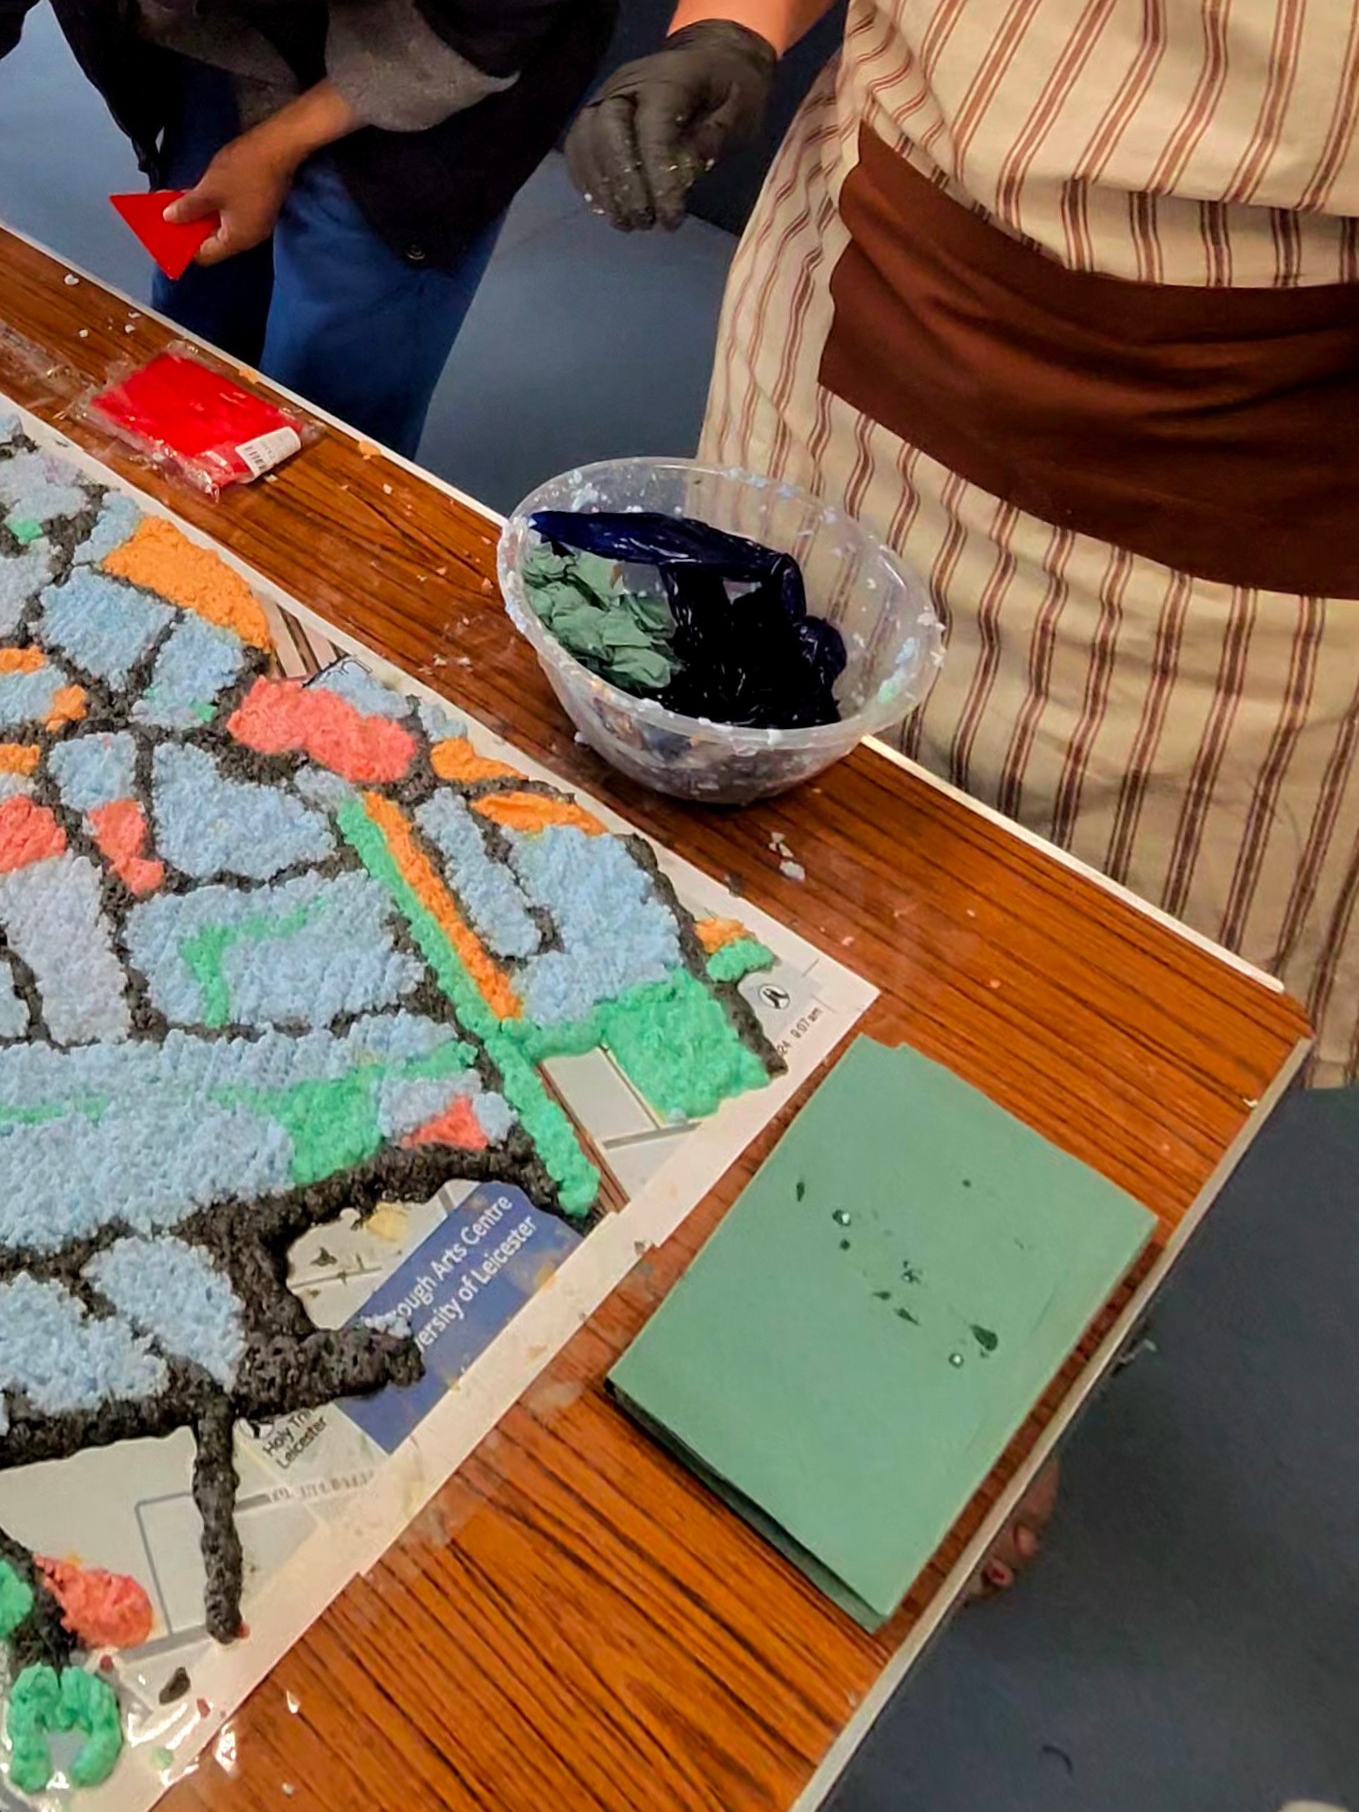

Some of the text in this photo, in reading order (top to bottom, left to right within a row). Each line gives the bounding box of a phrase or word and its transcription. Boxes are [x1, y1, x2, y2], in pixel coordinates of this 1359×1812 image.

[807, 1007, 824, 1023] am
[430, 1194, 514, 1283] Arts Centre
[458, 1275, 480, 1302] of
[470, 1214, 538, 1287] Leicester
[262, 1426, 295, 1457] Holy
[275, 1415, 328, 1470] Leicester
